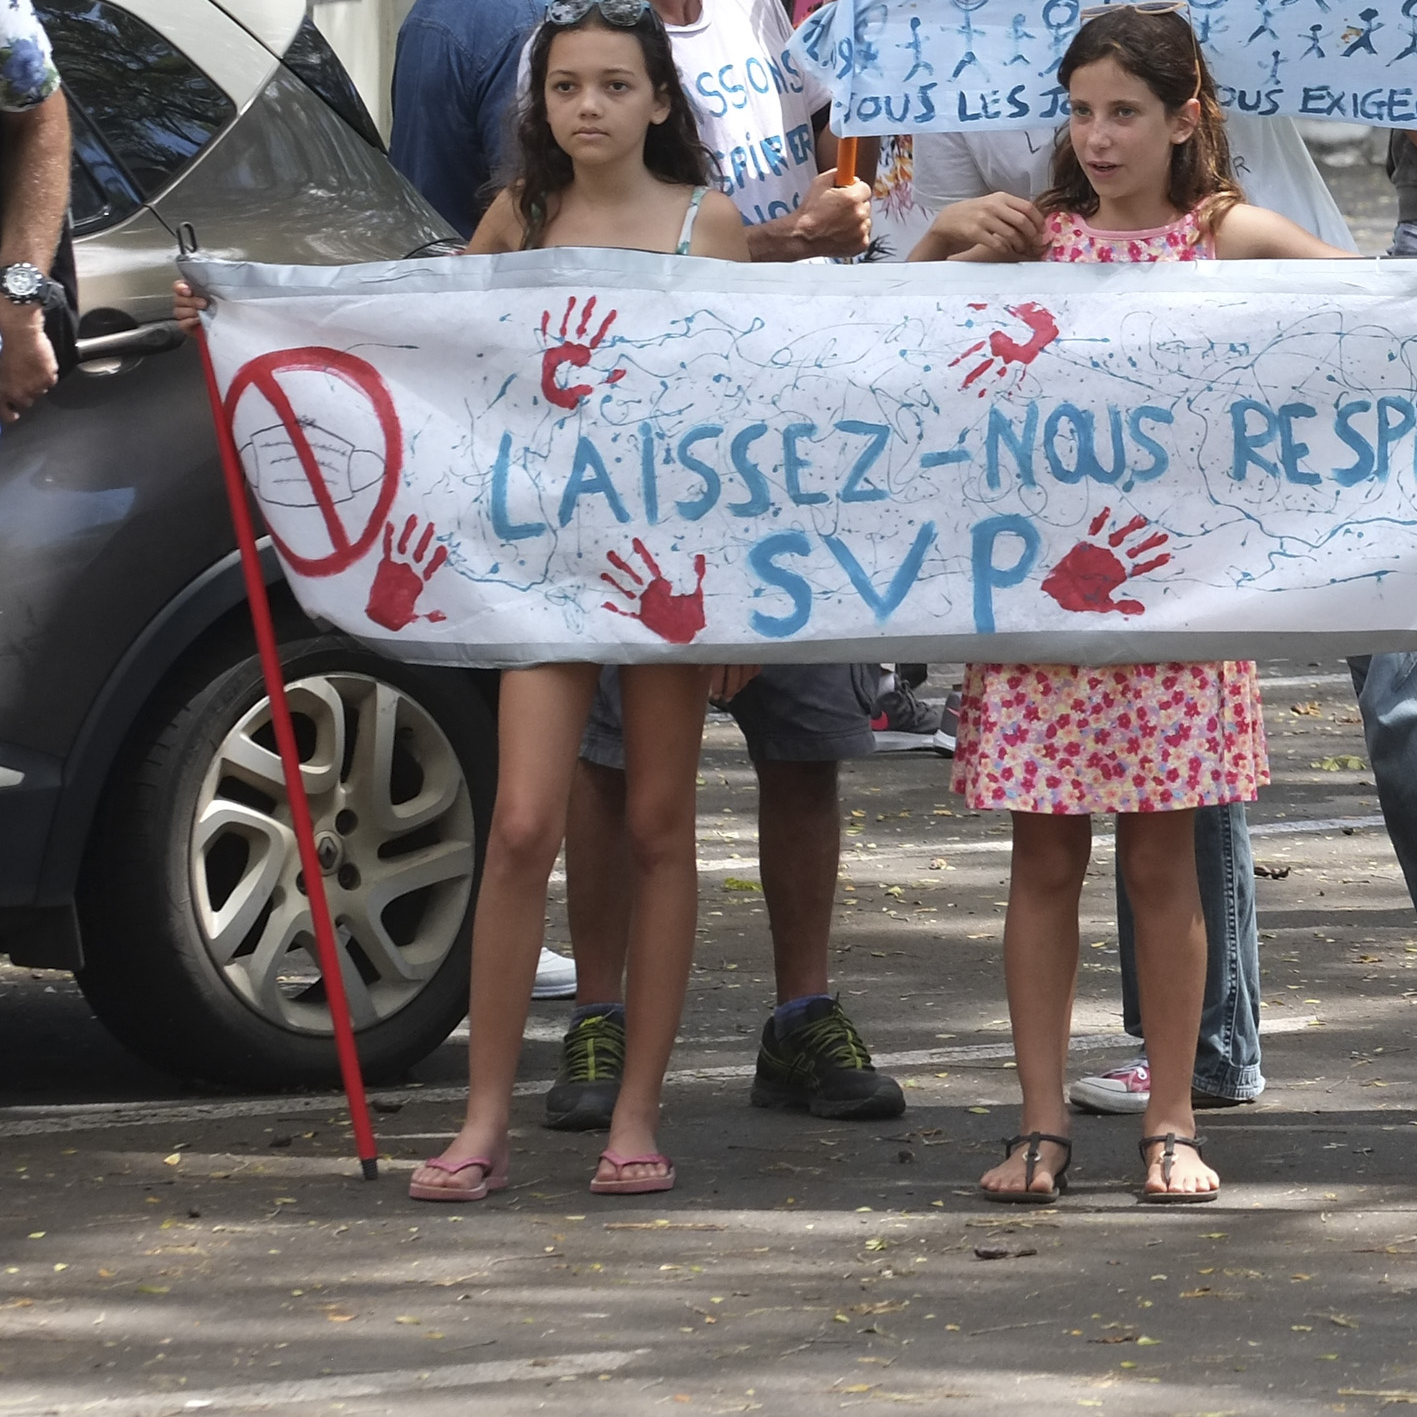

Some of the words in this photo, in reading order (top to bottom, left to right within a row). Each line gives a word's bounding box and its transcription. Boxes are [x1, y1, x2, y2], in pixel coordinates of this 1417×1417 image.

[957, 83, 1031, 123] LES
[1216, 84, 1284, 116] OUS
[747, 513, 1041, 639] SVP
